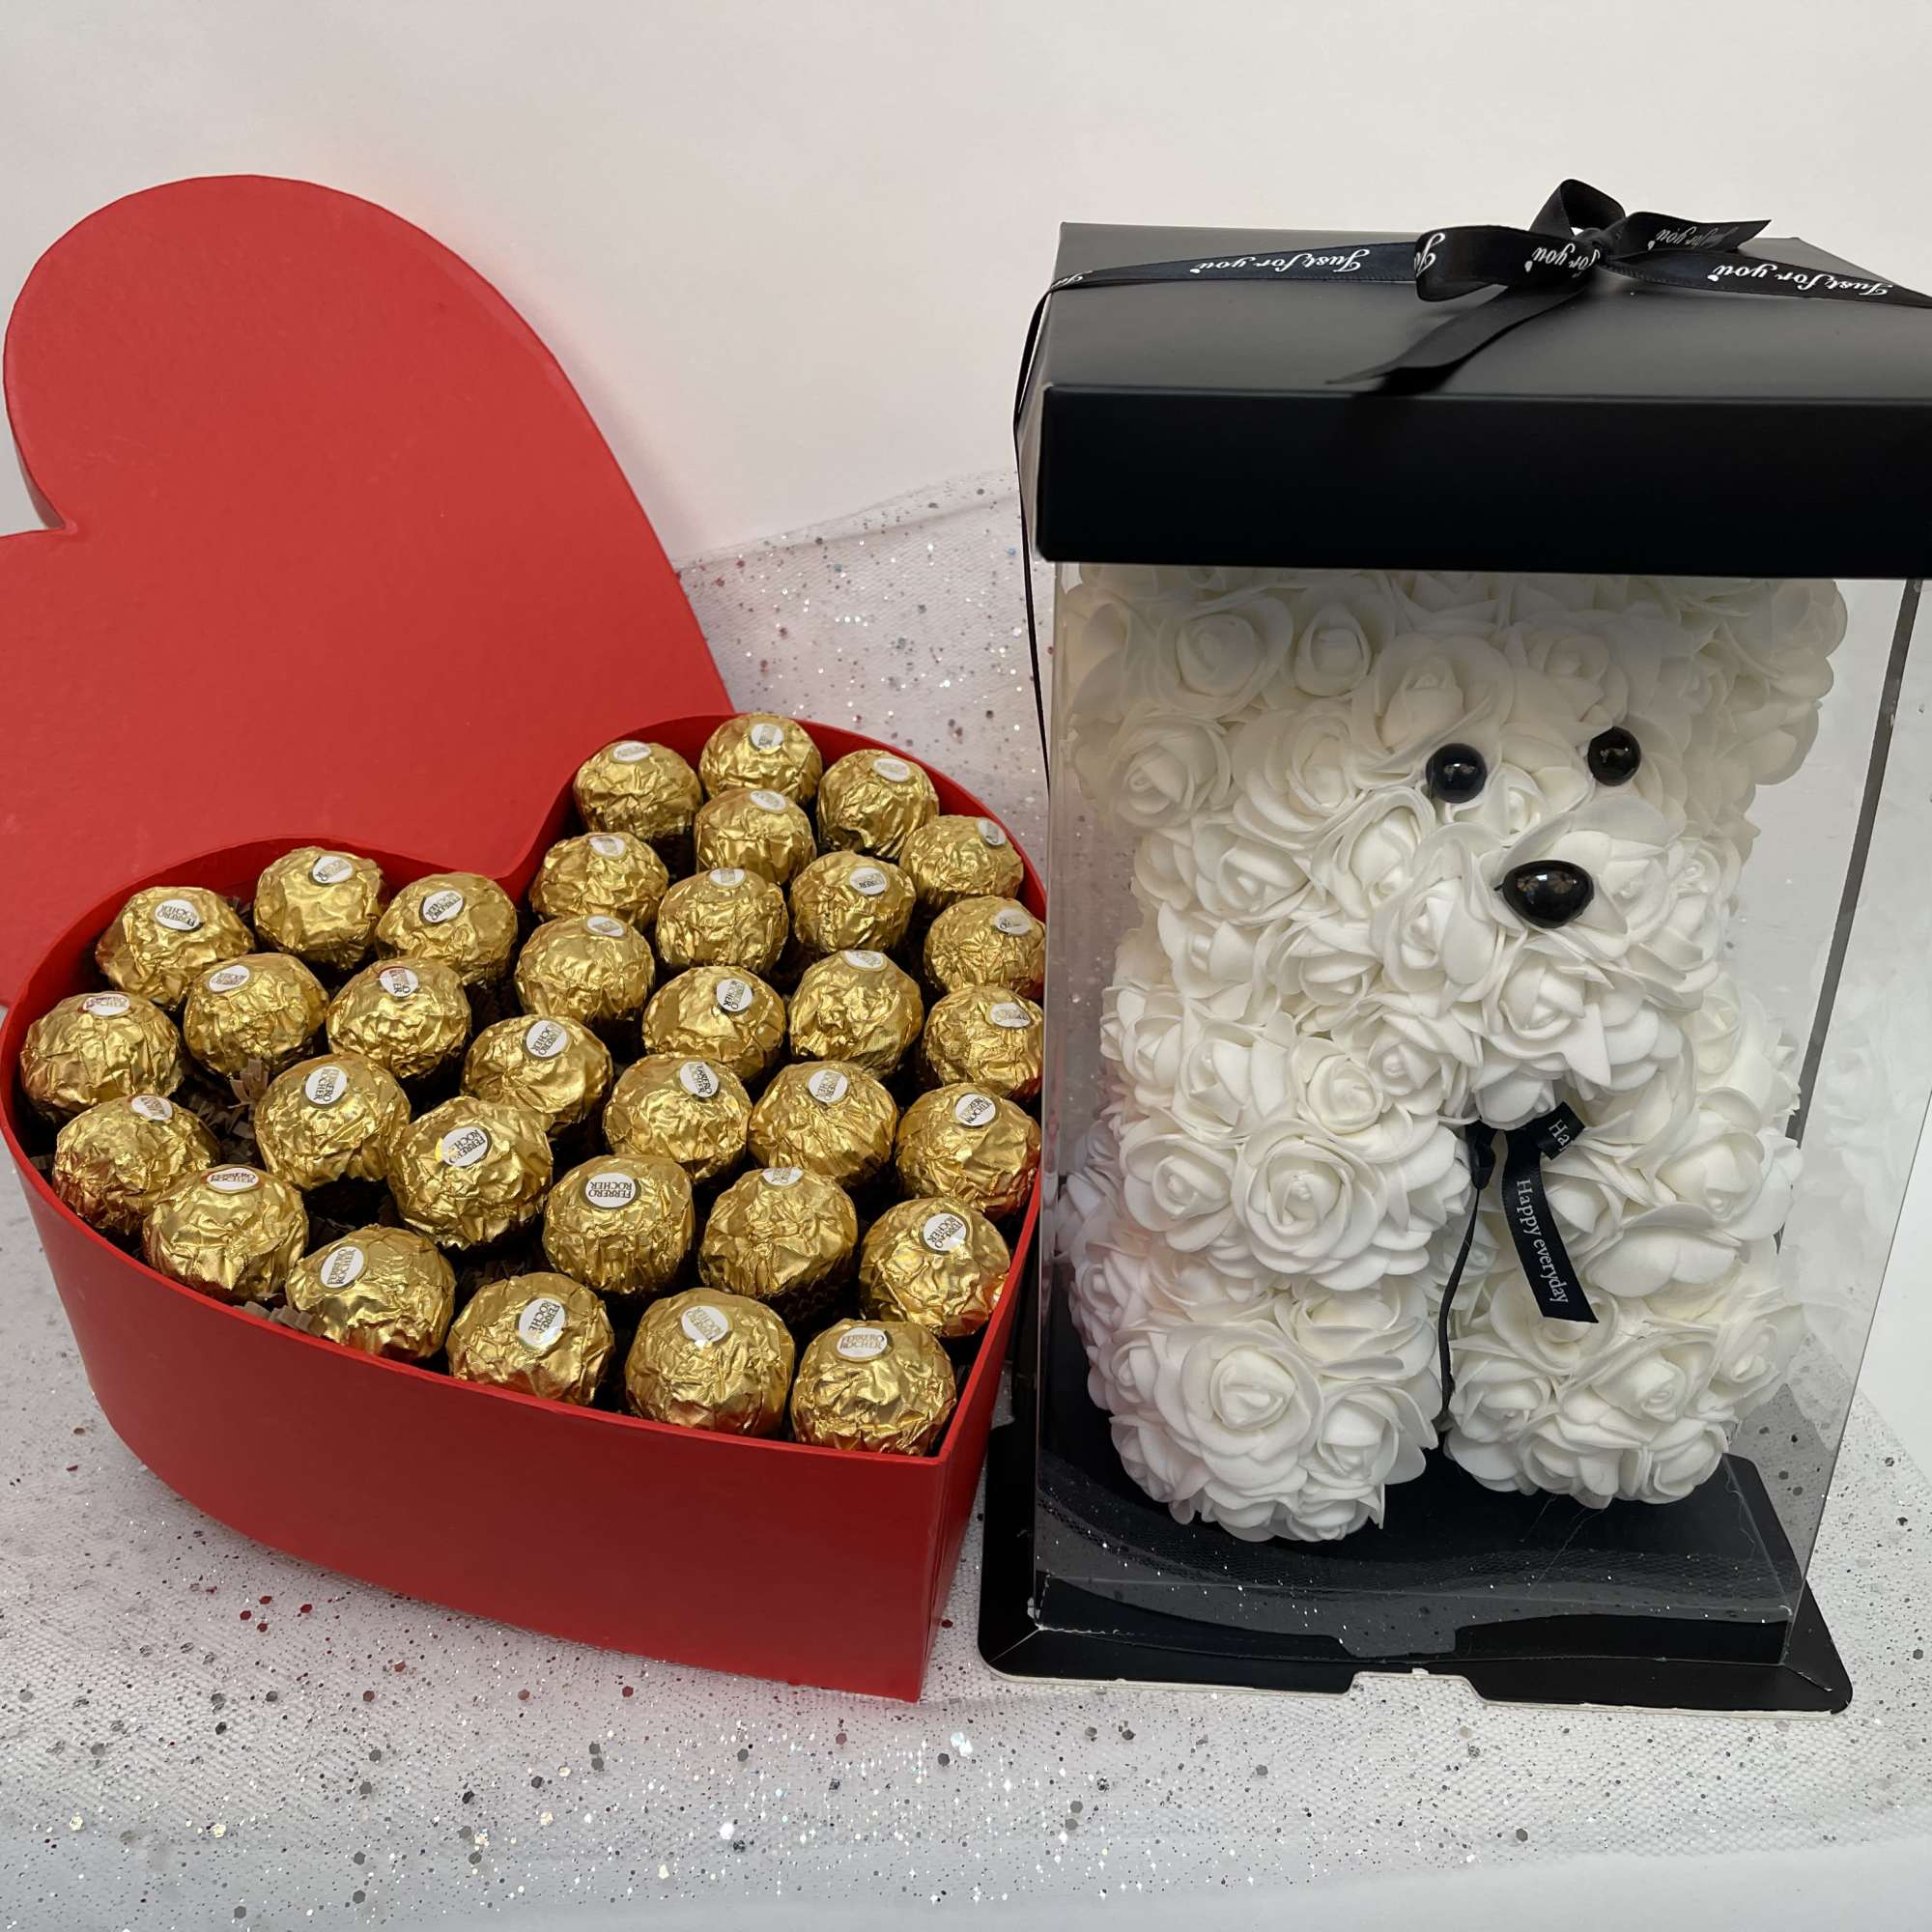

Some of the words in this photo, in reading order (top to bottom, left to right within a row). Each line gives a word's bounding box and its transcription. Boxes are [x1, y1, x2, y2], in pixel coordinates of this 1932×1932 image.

[1197, 256, 1257, 269] you
[1255, 252, 1313, 272] for
[1304, 249, 1370, 272] Just
[1532, 242, 1576, 266] you
[1712, 263, 1777, 278] you
[1775, 273, 1835, 291] for
[1825, 277, 1893, 296] Just
[588, 1189, 632, 1199] FERRERO
[590, 1181, 633, 1190] ROCHER
[1517, 1179, 1542, 1236] Happy
[1533, 1237, 1569, 1303] everyday
